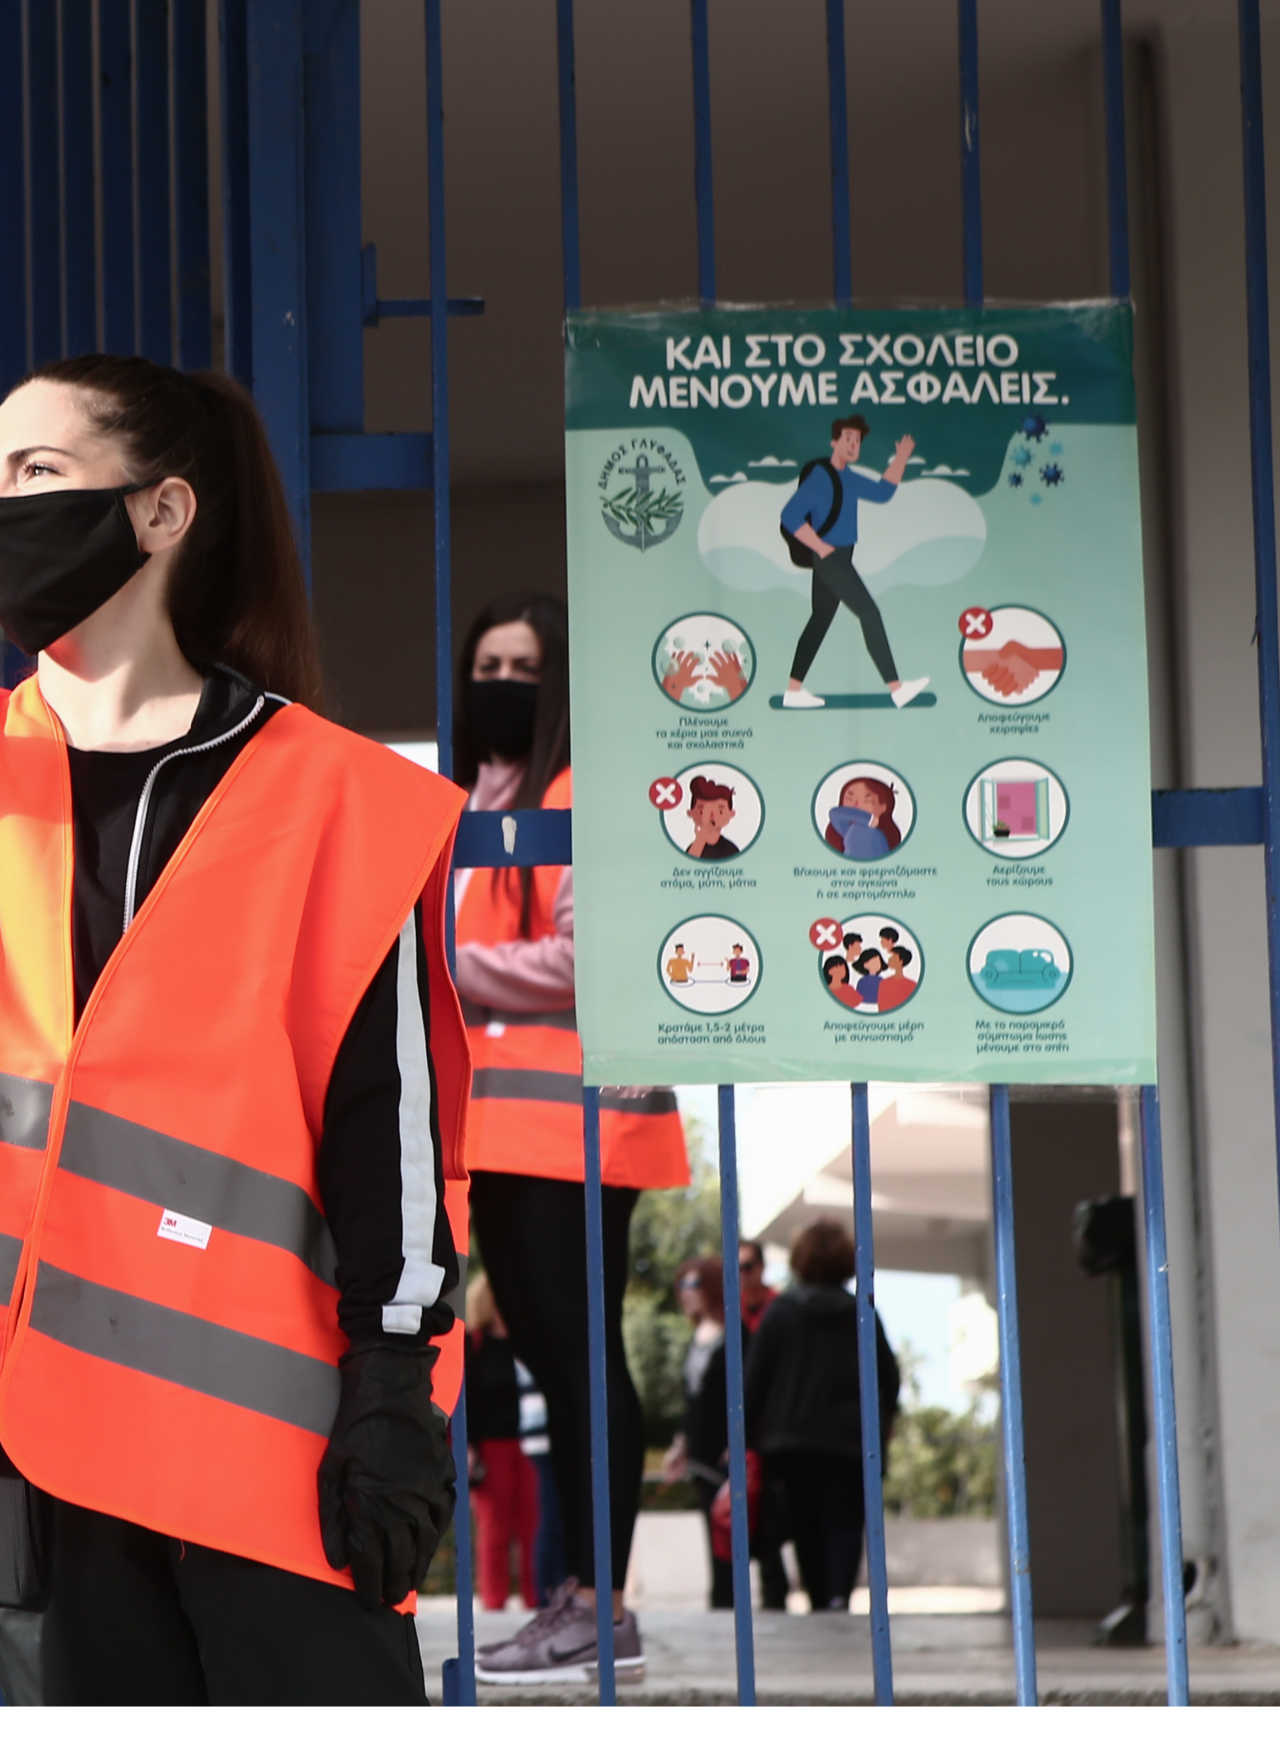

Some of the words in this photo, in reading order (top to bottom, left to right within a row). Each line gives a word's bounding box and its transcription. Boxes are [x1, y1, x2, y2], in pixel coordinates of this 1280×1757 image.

[666, 336, 731, 370] ΚΑΙ
[745, 334, 826, 368] ΣΤΟ
[839, 334, 1018, 367] ΣΧΟΛΕΙΟ
[629, 373, 838, 409] ΜΕΝΟΥΜΕ
[850, 372, 1070, 405] ΑΣΦΑΛΕΙΣ.
[598, 444, 627, 490] ΔΗΜΟΣ
[631, 438, 686, 485] ΓΛΥΦΑΔΑΣ
[672, 866, 691, 877] Δεν
[658, 1022, 702, 1034] Κρατάμε
[734, 1021, 765, 1034] μέτρα
